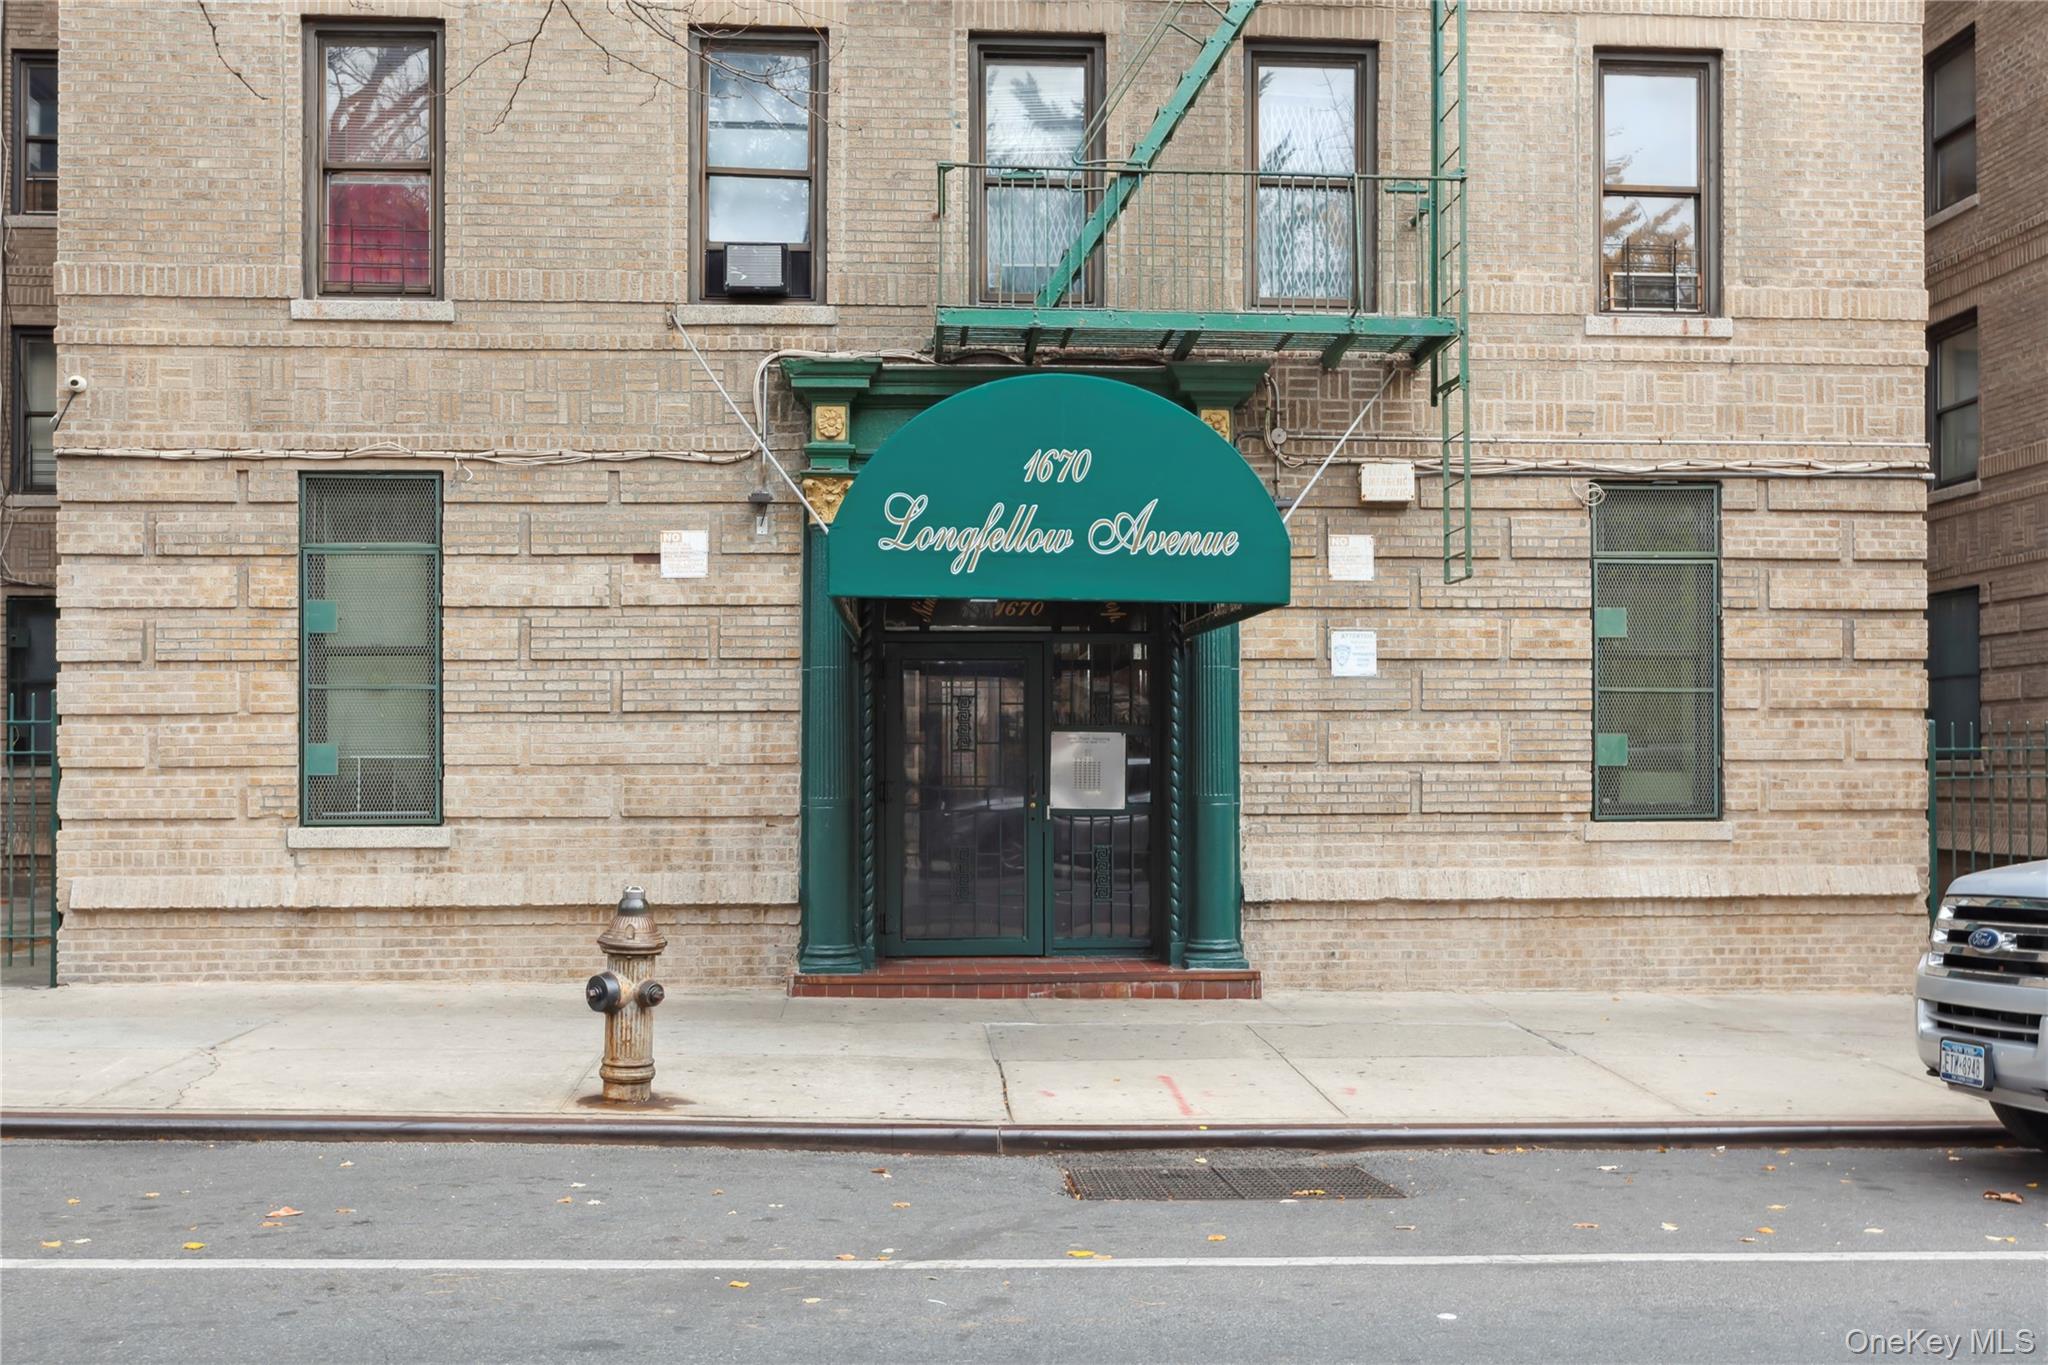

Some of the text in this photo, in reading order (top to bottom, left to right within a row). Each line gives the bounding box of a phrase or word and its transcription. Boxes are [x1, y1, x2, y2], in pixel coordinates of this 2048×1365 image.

[1023, 448, 1092, 483] 1670
[663, 533, 681, 543] NO
[878, 491, 1240, 575] Longfellow Avenue
[1332, 538, 1348, 546] NO
[994, 601, 1044, 617] 1670
[1972, 931, 1992, 947] Ford
